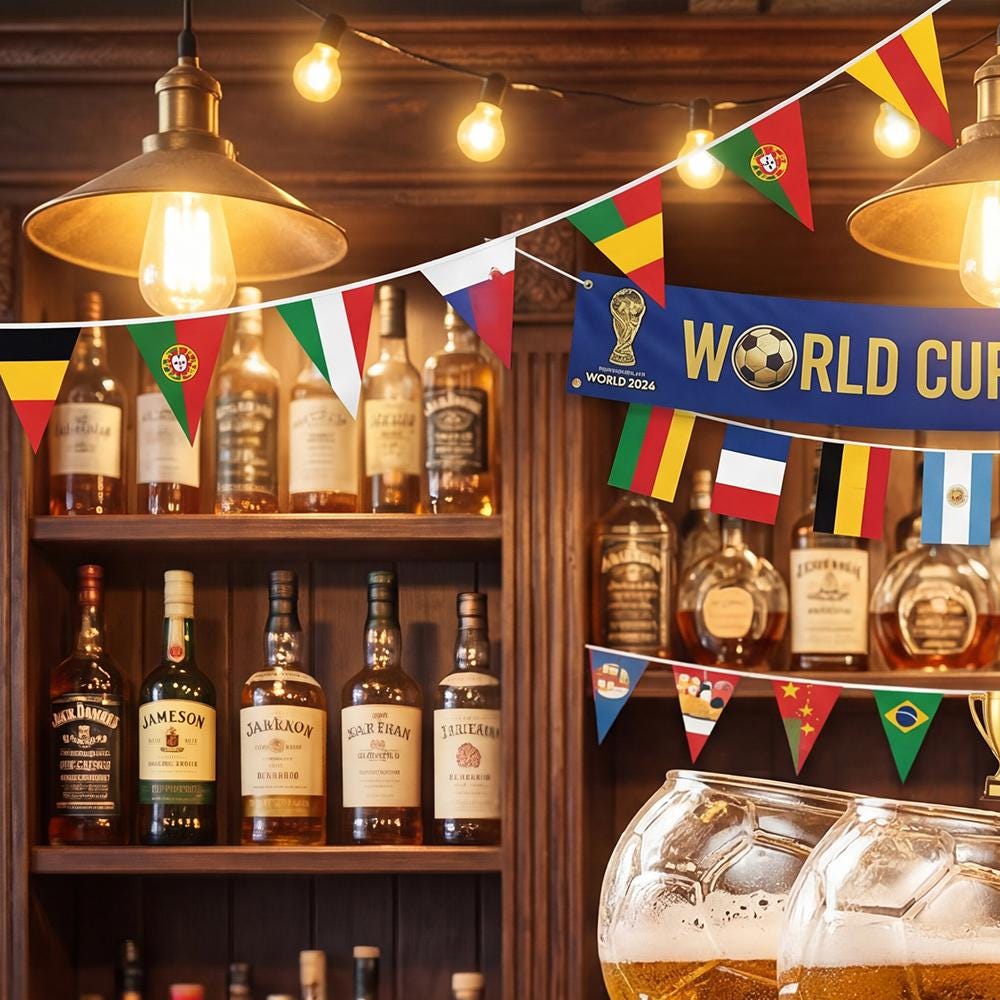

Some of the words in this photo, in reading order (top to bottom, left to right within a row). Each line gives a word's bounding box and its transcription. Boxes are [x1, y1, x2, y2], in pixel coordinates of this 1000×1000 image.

[683, 319, 899, 396] WORLD
[586, 371, 626, 387] WORLD
[142, 710, 206, 730] JAMESON
